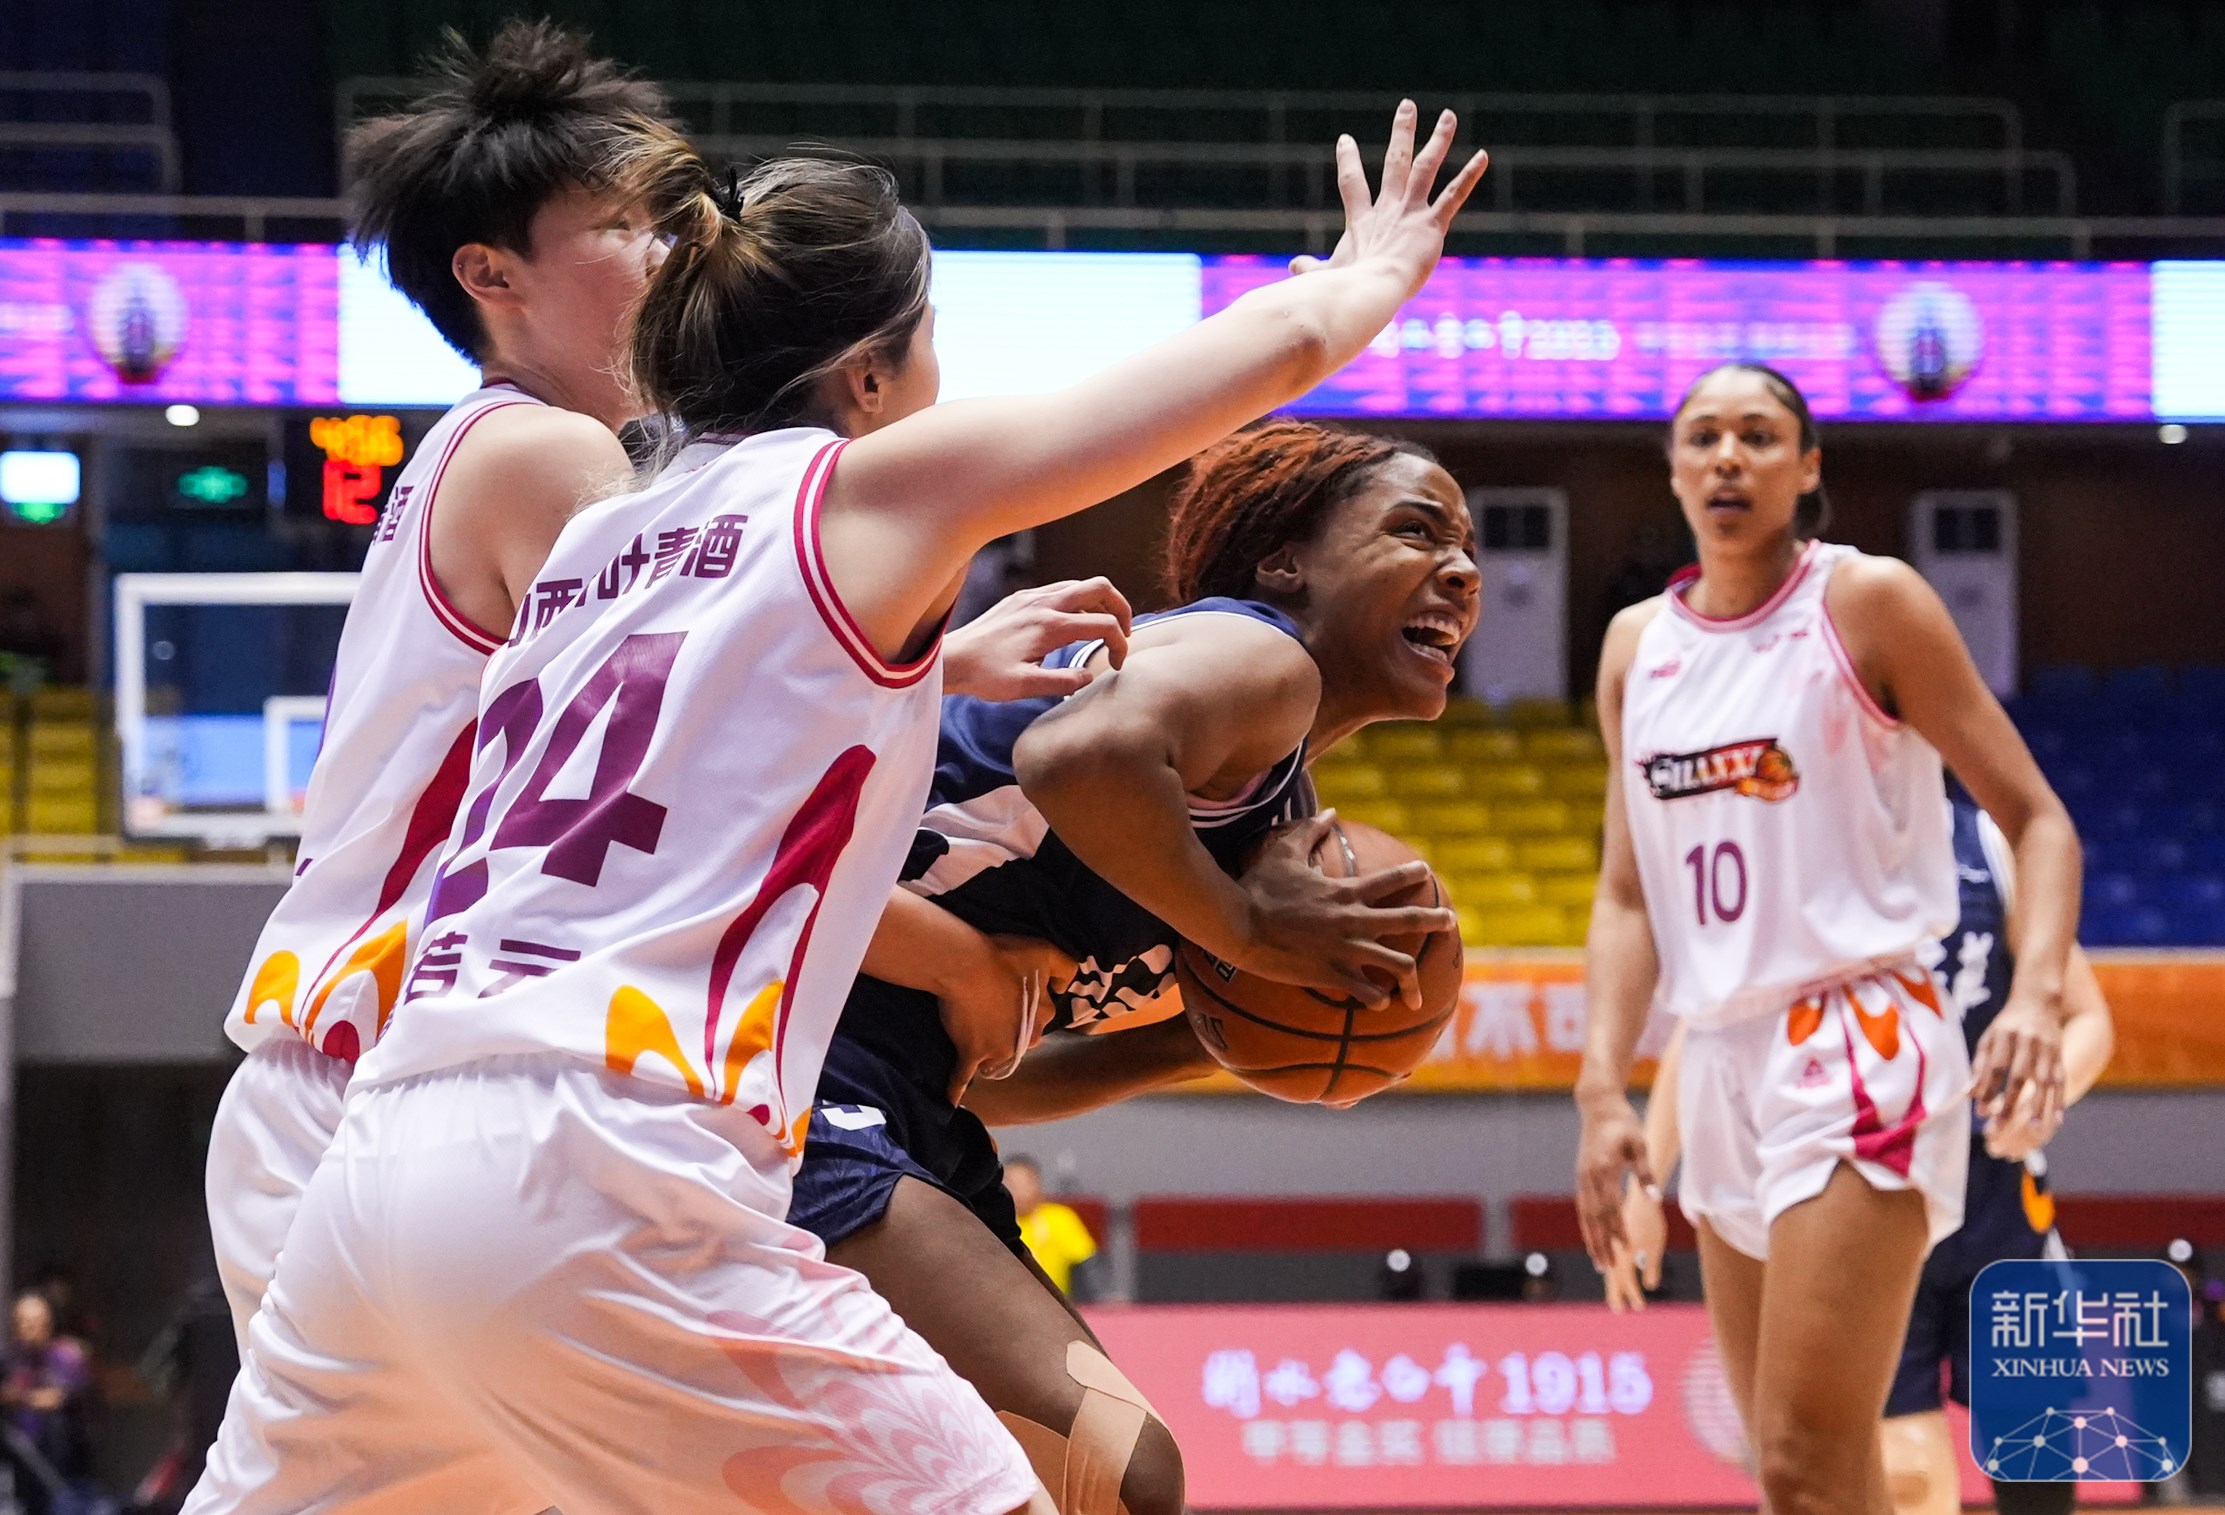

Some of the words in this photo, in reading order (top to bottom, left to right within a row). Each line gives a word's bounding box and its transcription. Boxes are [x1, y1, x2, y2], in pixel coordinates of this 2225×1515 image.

[508, 514, 748, 648] 西叶青酒
[424, 631, 690, 930] 24
[1686, 841, 1747, 926] 10
[1498, 1352, 1653, 1415] 1915
